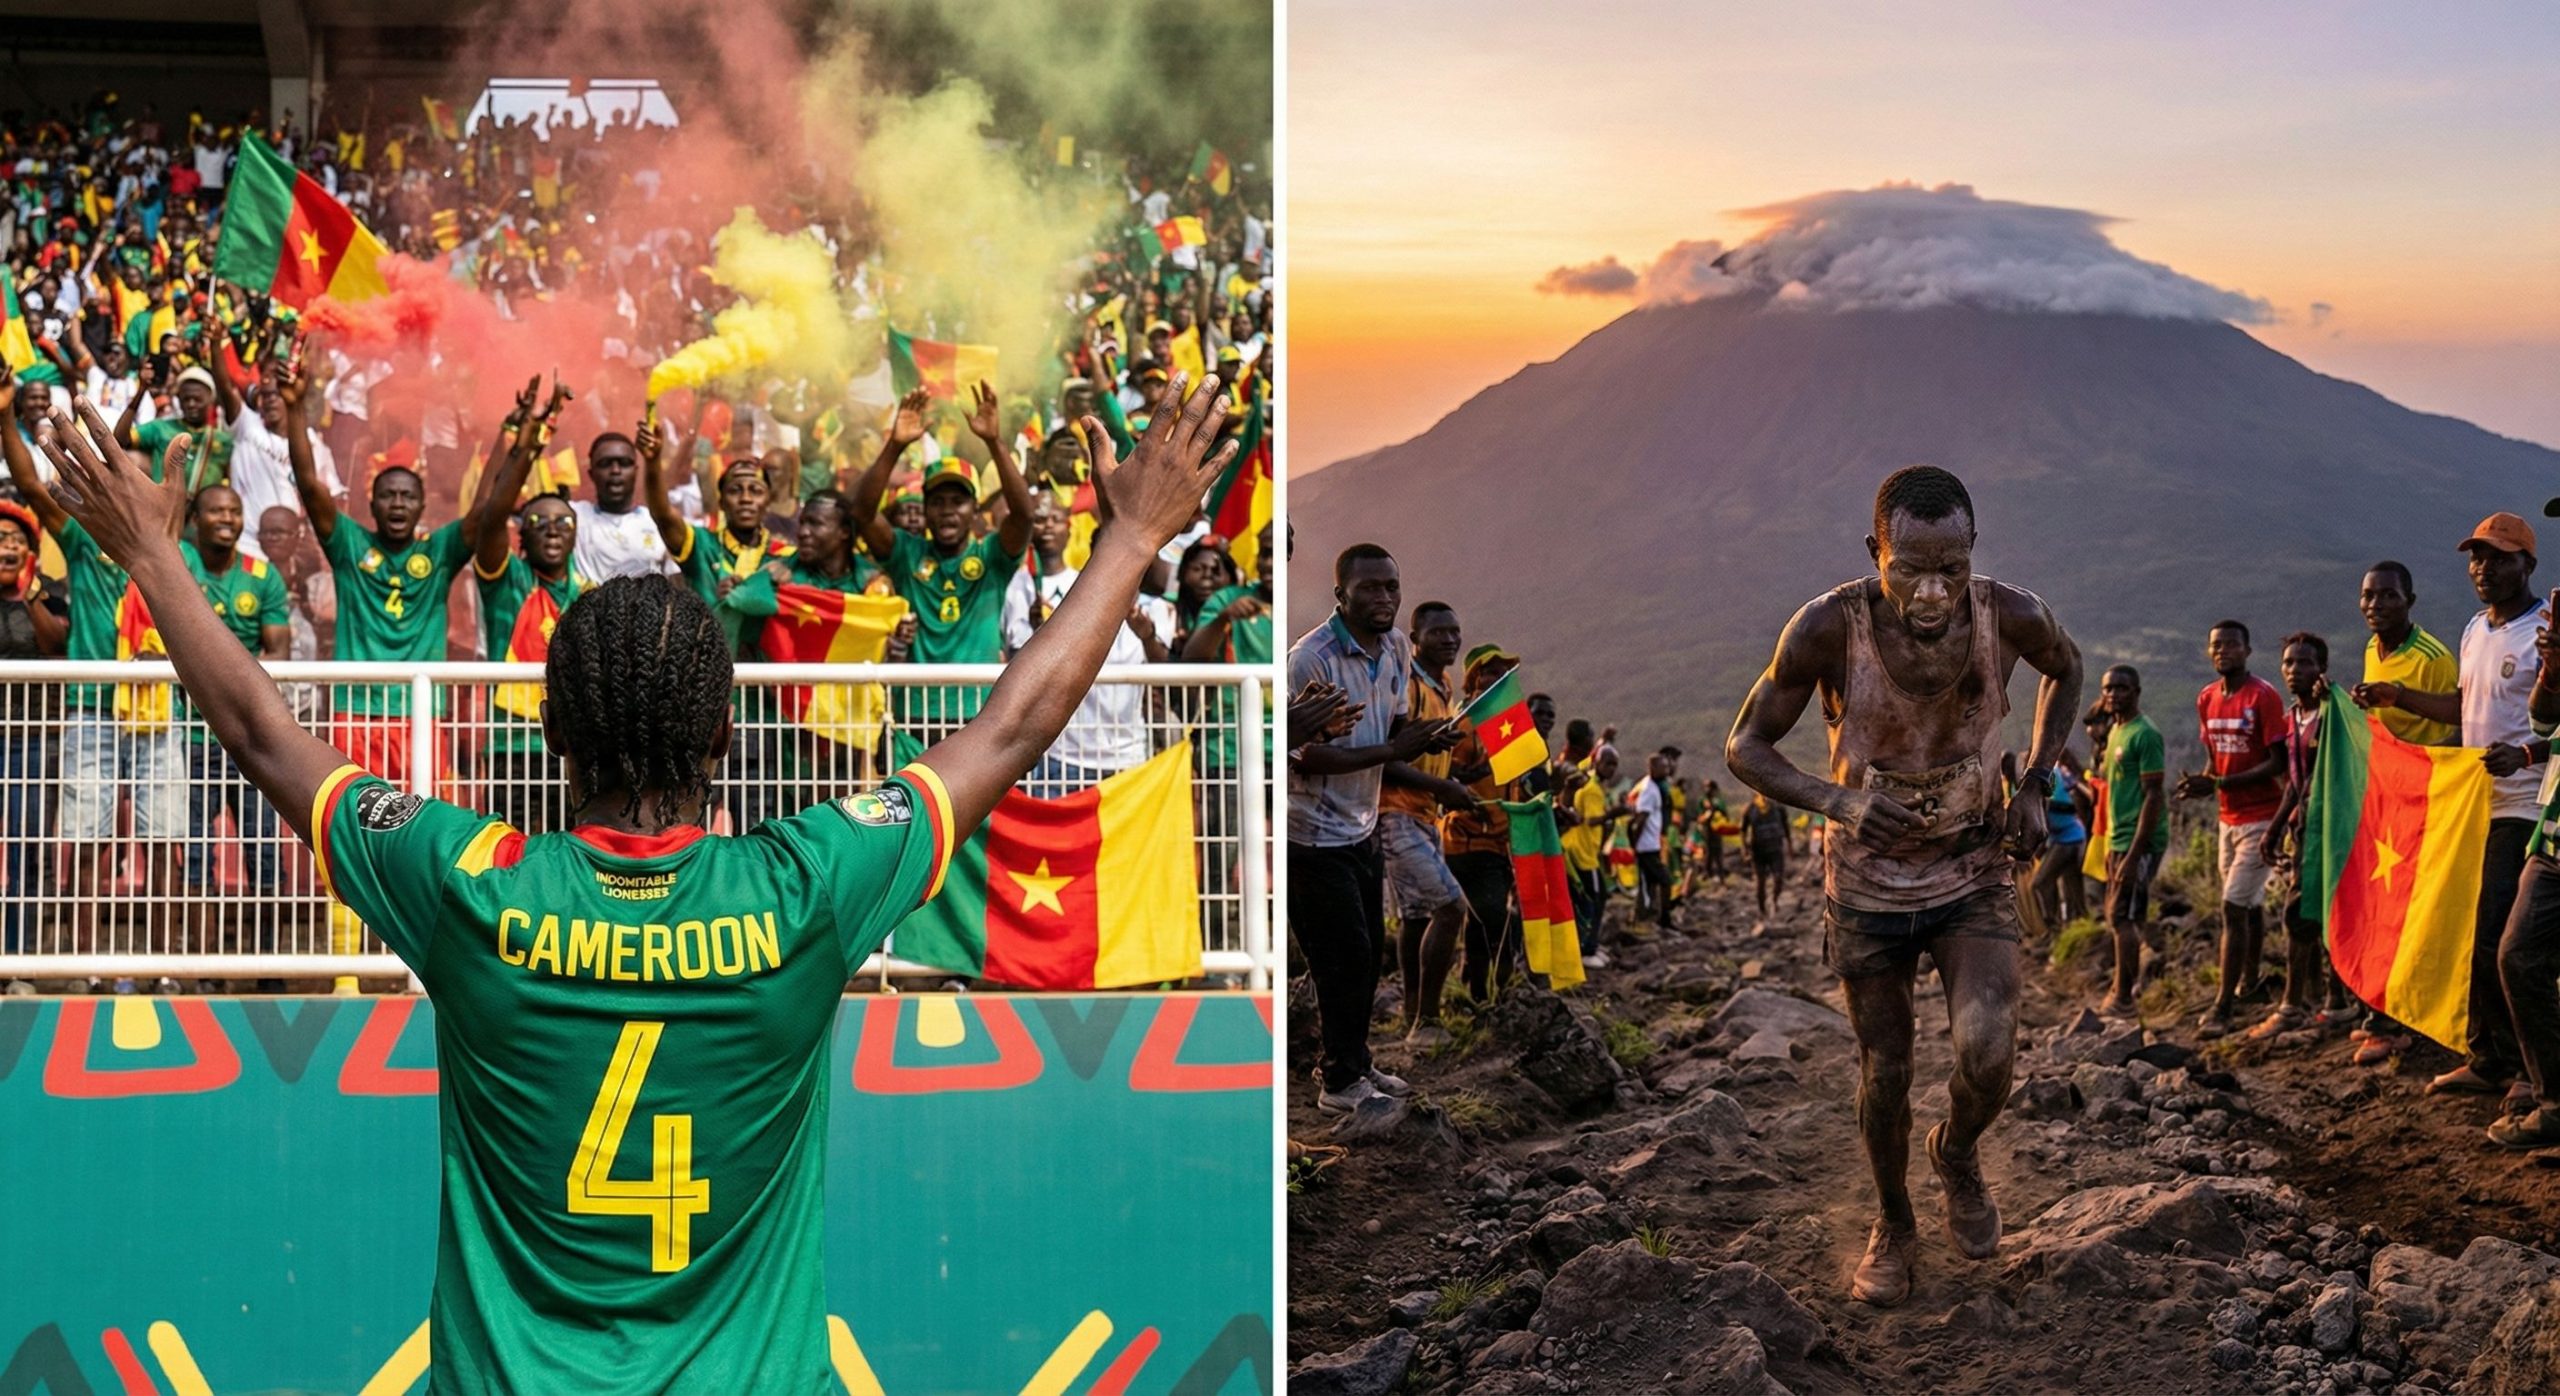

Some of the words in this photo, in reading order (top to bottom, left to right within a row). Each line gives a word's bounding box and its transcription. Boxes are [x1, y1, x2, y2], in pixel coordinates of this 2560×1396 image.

[385, 588, 404, 619] 4
[596, 871, 676, 887] INDOMITABLE
[602, 886, 669, 900] LIONESSES
[499, 908, 781, 981] CAMEROON
[567, 1021, 710, 1273] 4
